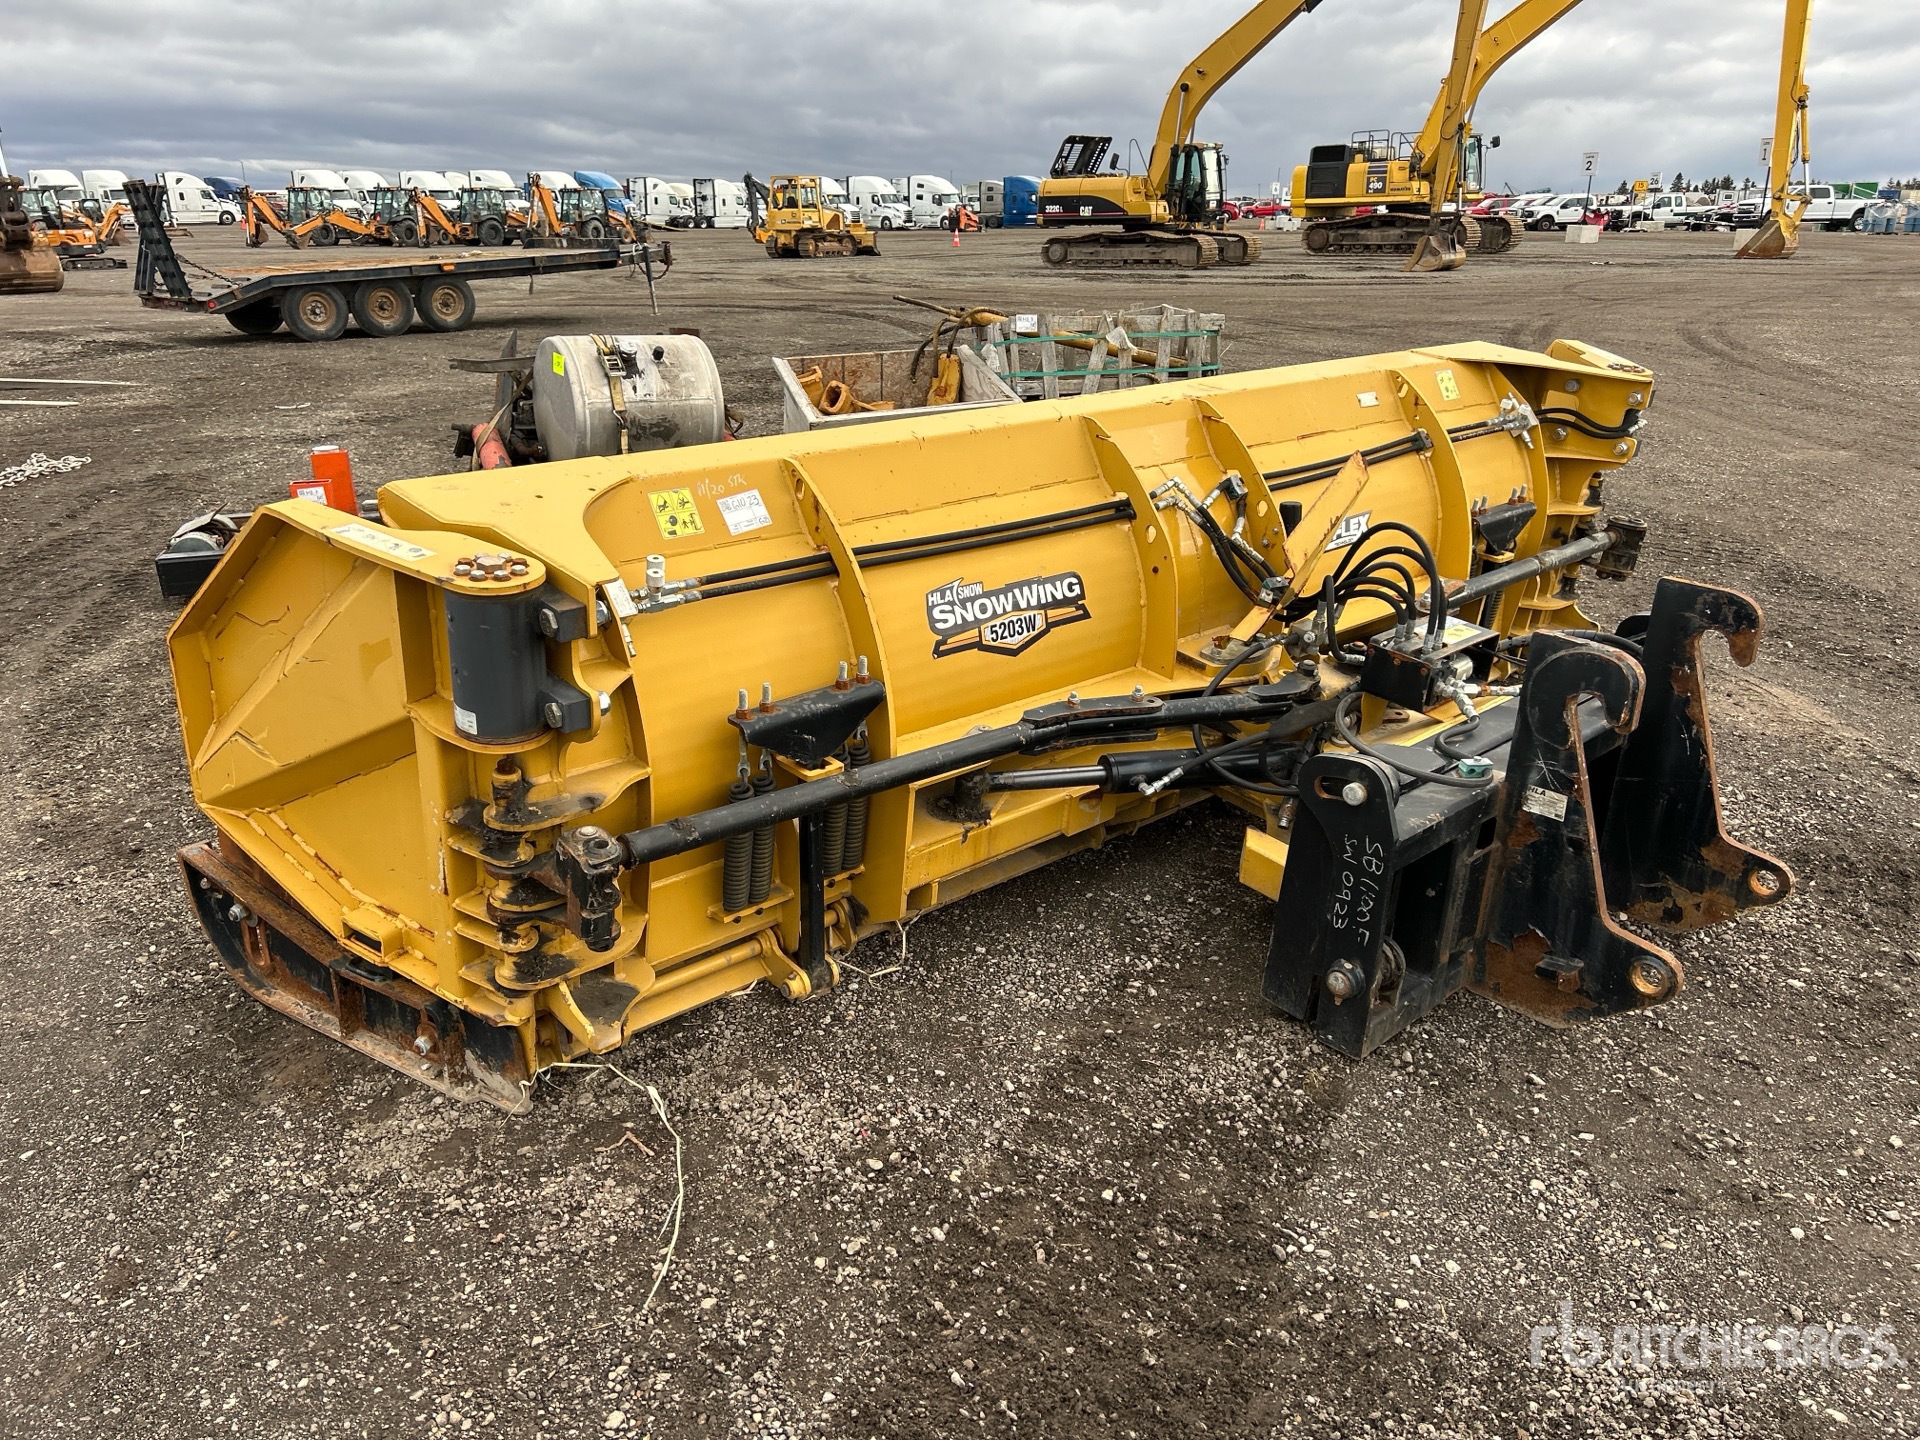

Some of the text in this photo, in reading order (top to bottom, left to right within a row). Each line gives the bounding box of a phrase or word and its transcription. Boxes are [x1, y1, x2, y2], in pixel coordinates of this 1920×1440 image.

[1761, 148, 1767, 161] 1
[1585, 160, 1593, 171] 2
[1080, 206, 1093, 216] CAT
[928, 582, 983, 607] HLA SNOW
[989, 612, 1037, 643] 5203W
[1528, 785, 1546, 797] HLA
